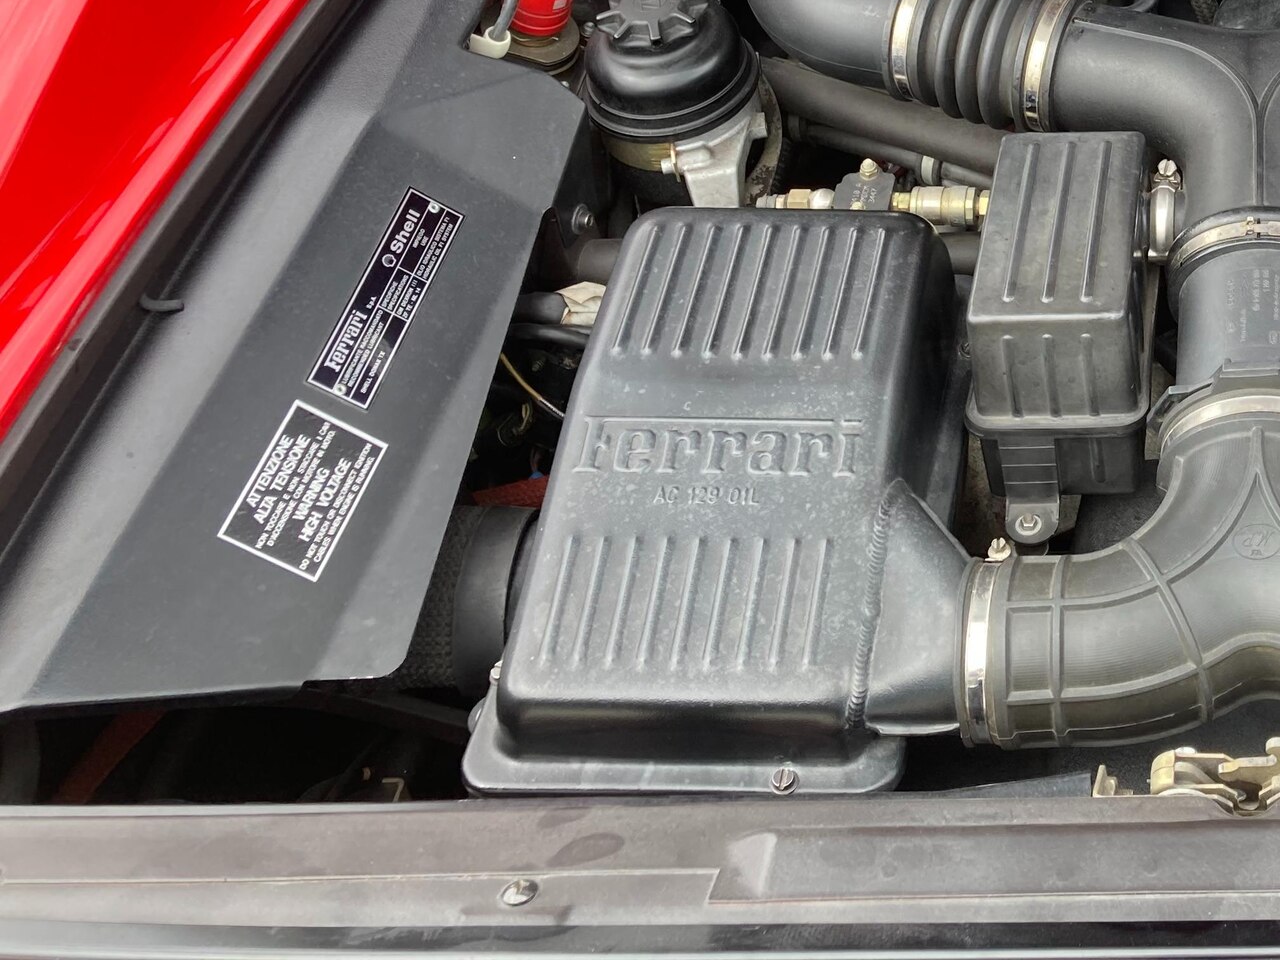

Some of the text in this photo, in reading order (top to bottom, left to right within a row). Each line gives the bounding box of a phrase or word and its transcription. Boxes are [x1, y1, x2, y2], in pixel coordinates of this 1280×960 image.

[390, 208, 420, 253] Shell
[323, 309, 367, 372] Ferrari
[360, 378, 372, 393] SHELL
[246, 434, 293, 507] ATTENZIONE
[292, 483, 305, 498] CON
[301, 457, 320, 483] MOTORE
[572, 415, 863, 478] Ferrari
[253, 434, 310, 523] ALTA TENSIONE
[255, 532, 268, 548] NON
[264, 501, 286, 530] TOCCARE
[286, 476, 299, 491] NON
[297, 441, 319, 473] STACCARE
[292, 467, 329, 519] WARNING
[298, 457, 351, 541] HIGH VOLTAGE
[298, 442, 372, 569] DO NOT TOUCH OR DISCONNECT IGNITION
[653, 486, 679, 504] AC
[687, 487, 721, 504] 129
[313, 536, 330, 562] CABLES
[327, 515, 342, 534] WHEN
[338, 492, 355, 515] ENGINE
